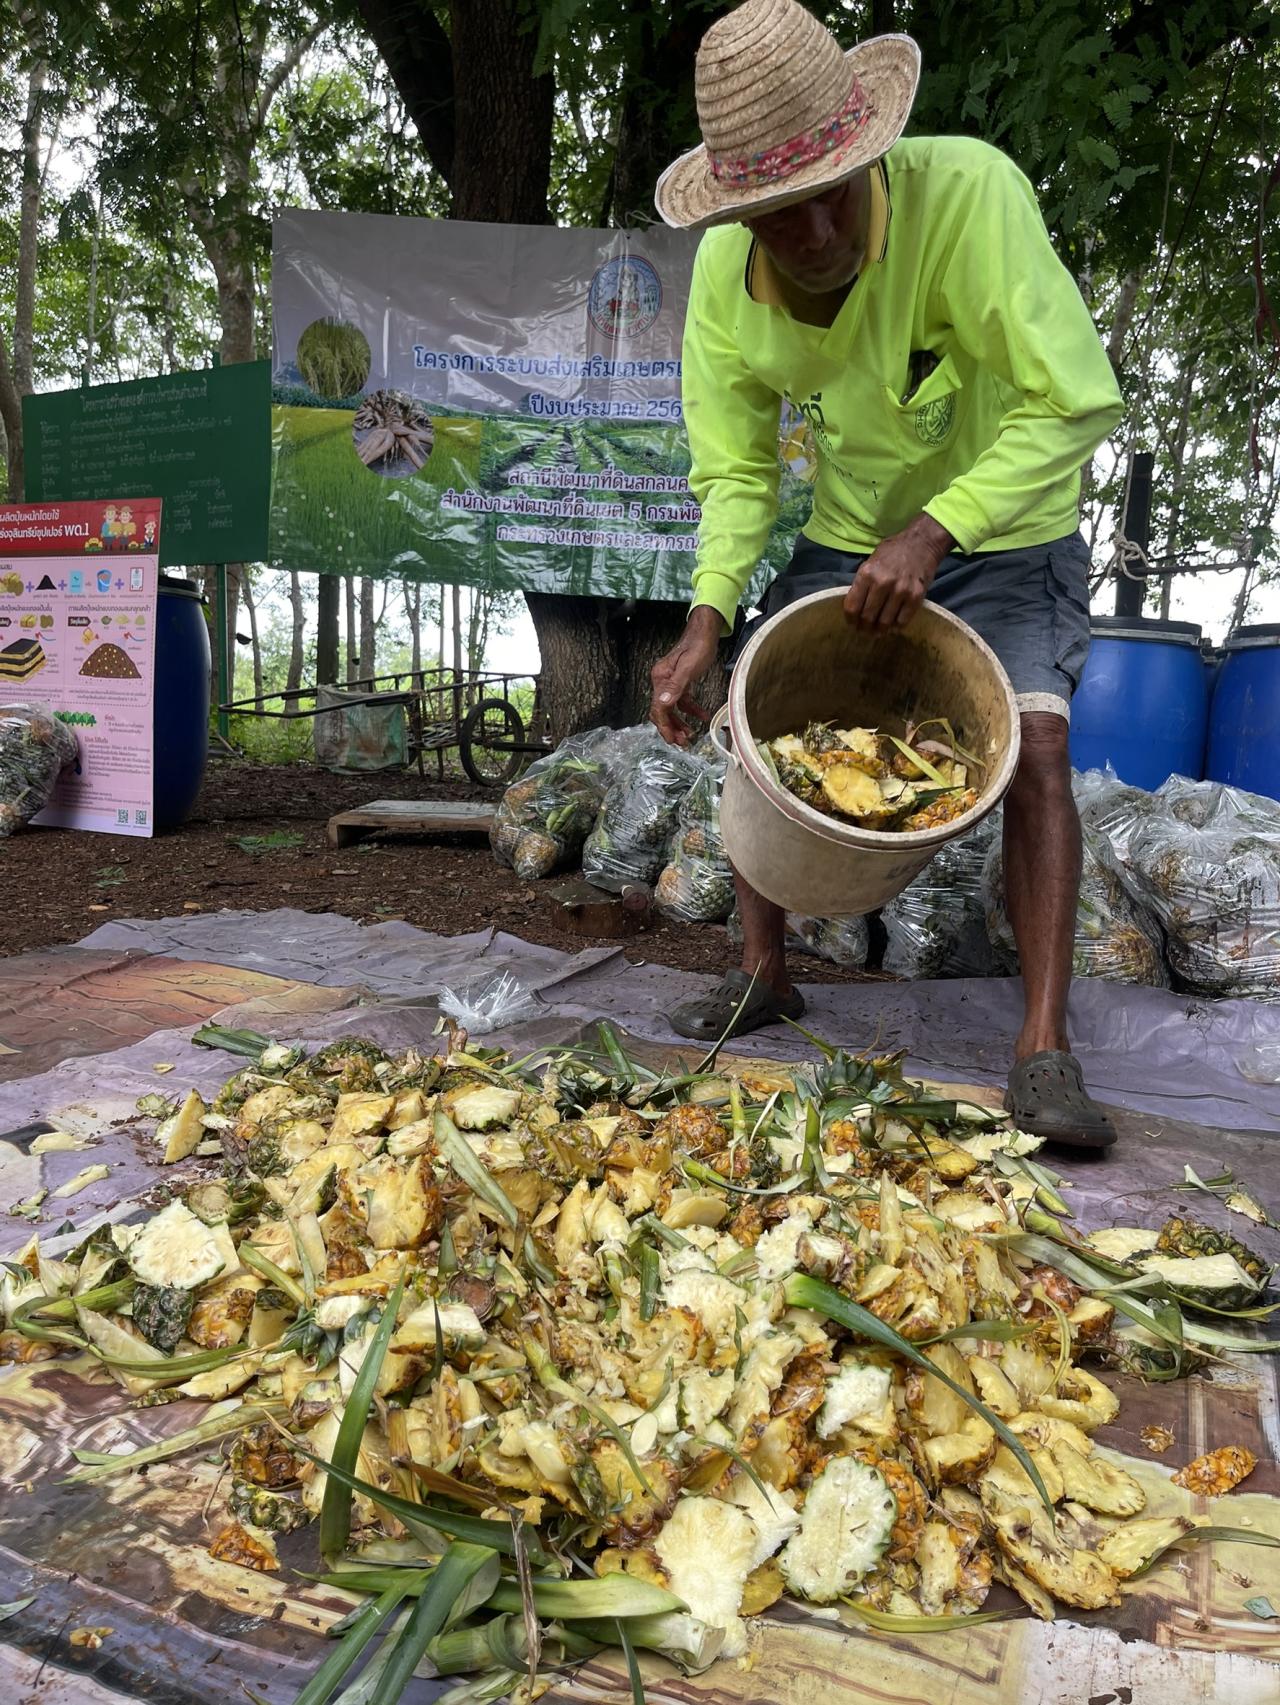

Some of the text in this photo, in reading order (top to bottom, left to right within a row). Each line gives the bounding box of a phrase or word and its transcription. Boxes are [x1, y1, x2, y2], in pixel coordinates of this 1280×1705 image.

[531, 395, 638, 416] ปีงบประมาณ
[441, 490, 623, 517] สำนักงานพัฒนาที่ดินเขต
[629, 503, 641, 520] 5
